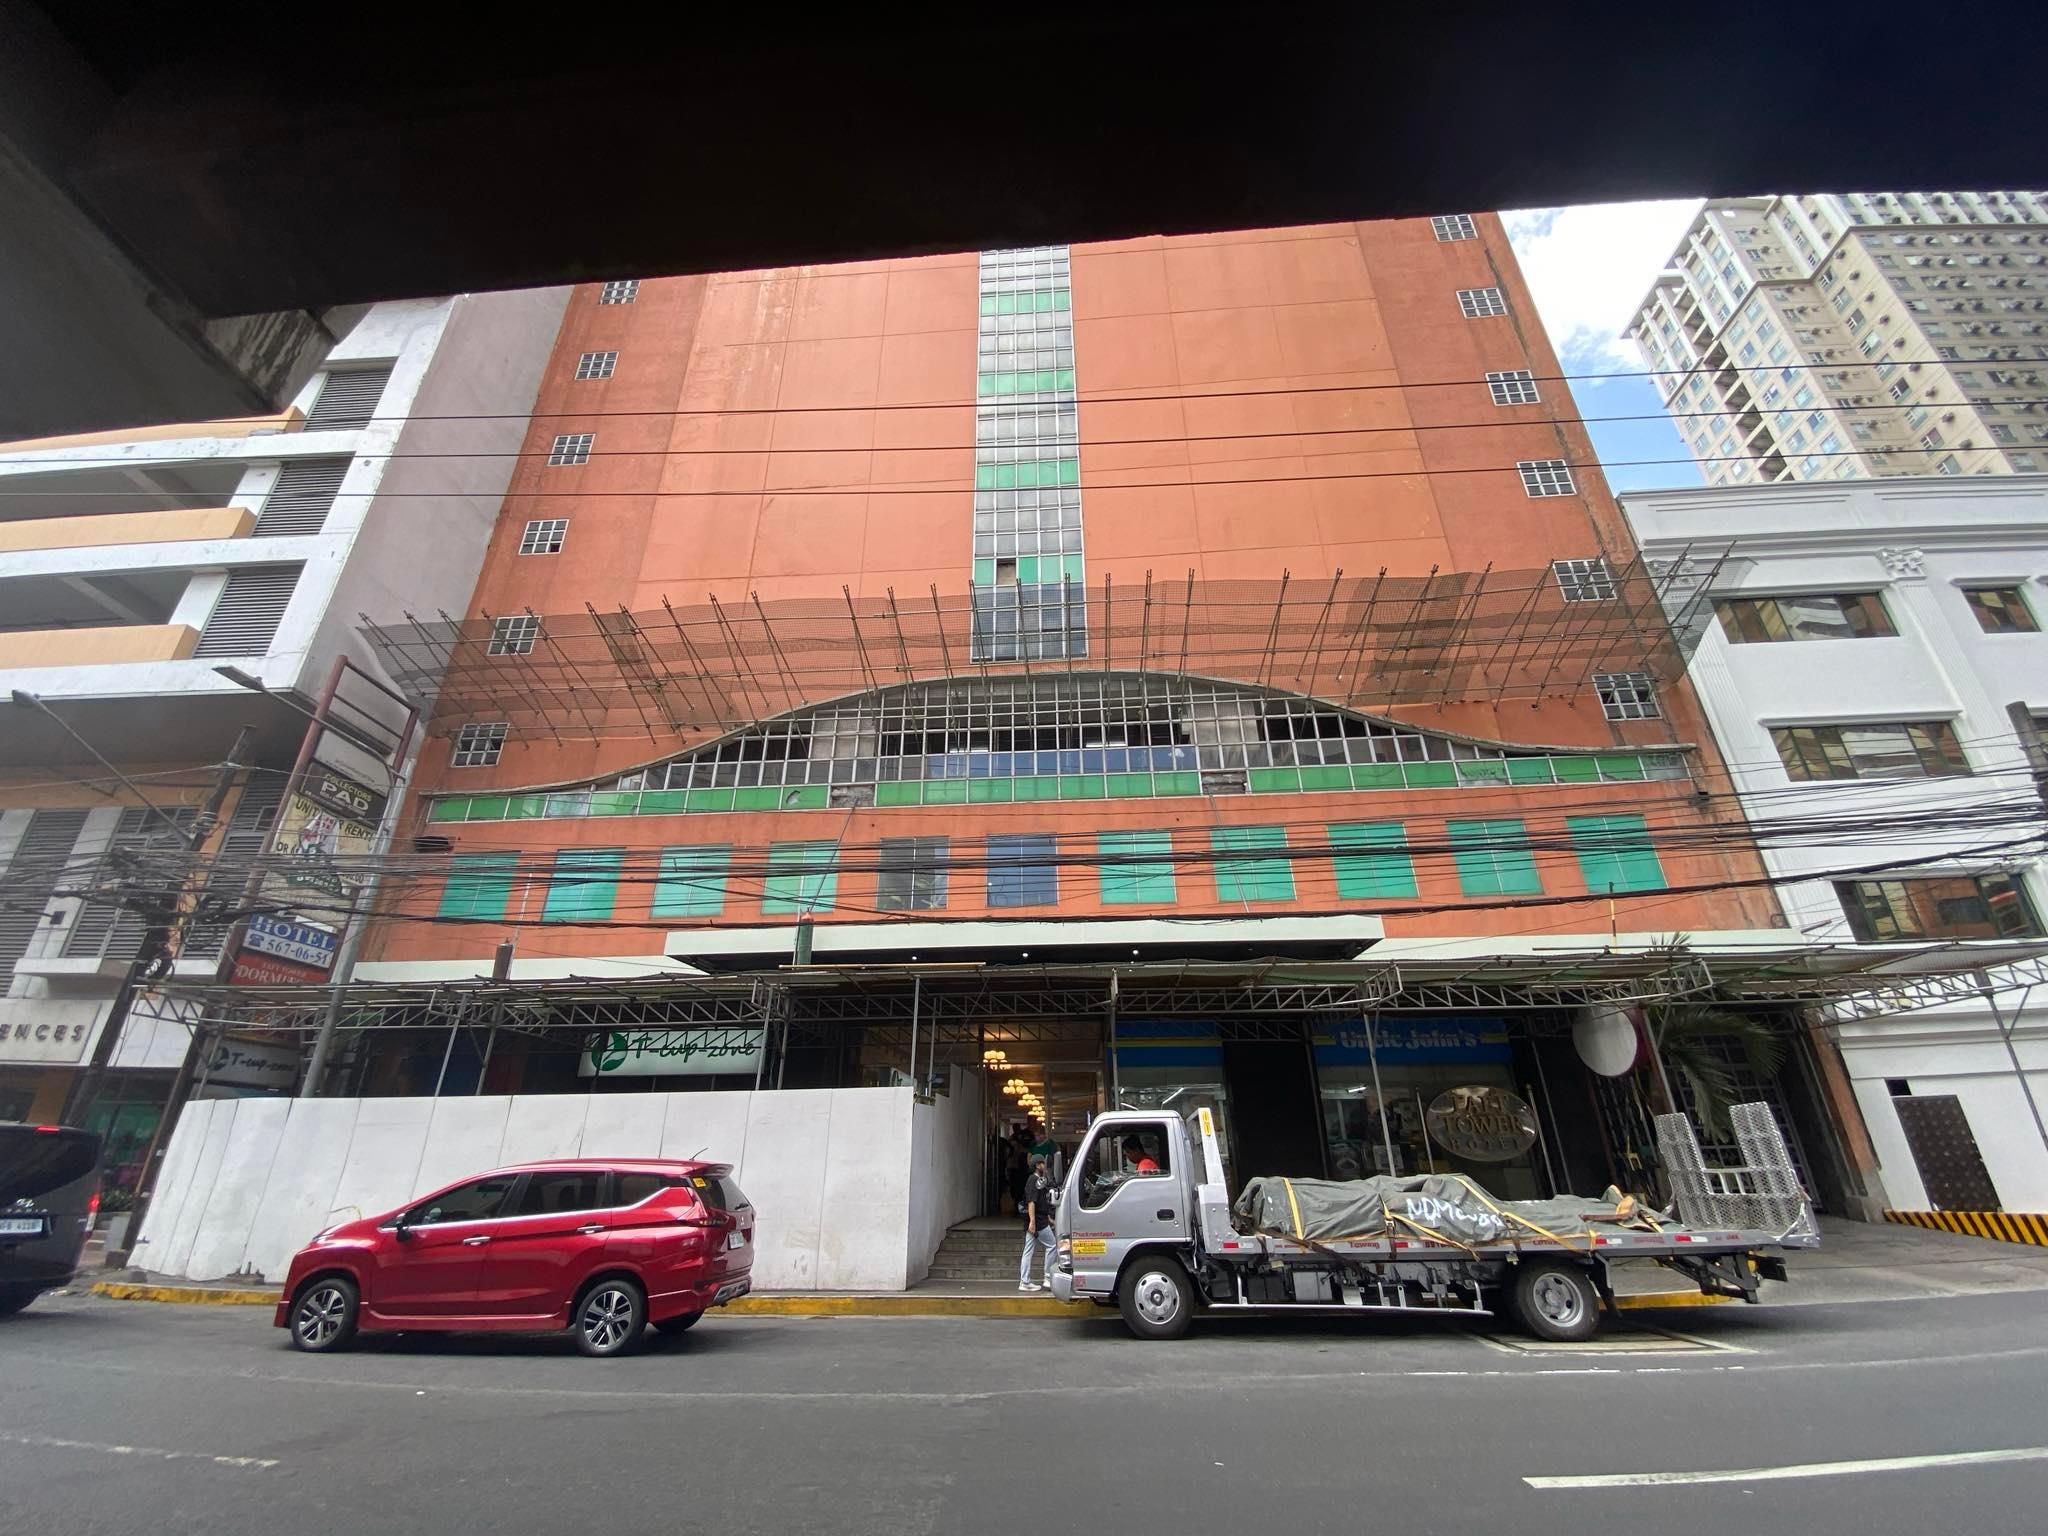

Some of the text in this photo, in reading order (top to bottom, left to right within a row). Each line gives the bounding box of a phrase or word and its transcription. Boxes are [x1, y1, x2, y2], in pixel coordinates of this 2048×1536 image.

[320, 780, 369, 812] PAD
[255, 915, 335, 951] HOTEL
[1341, 1029, 1479, 1049] Uncle John's
[1440, 1114, 1523, 1136] TOWER
